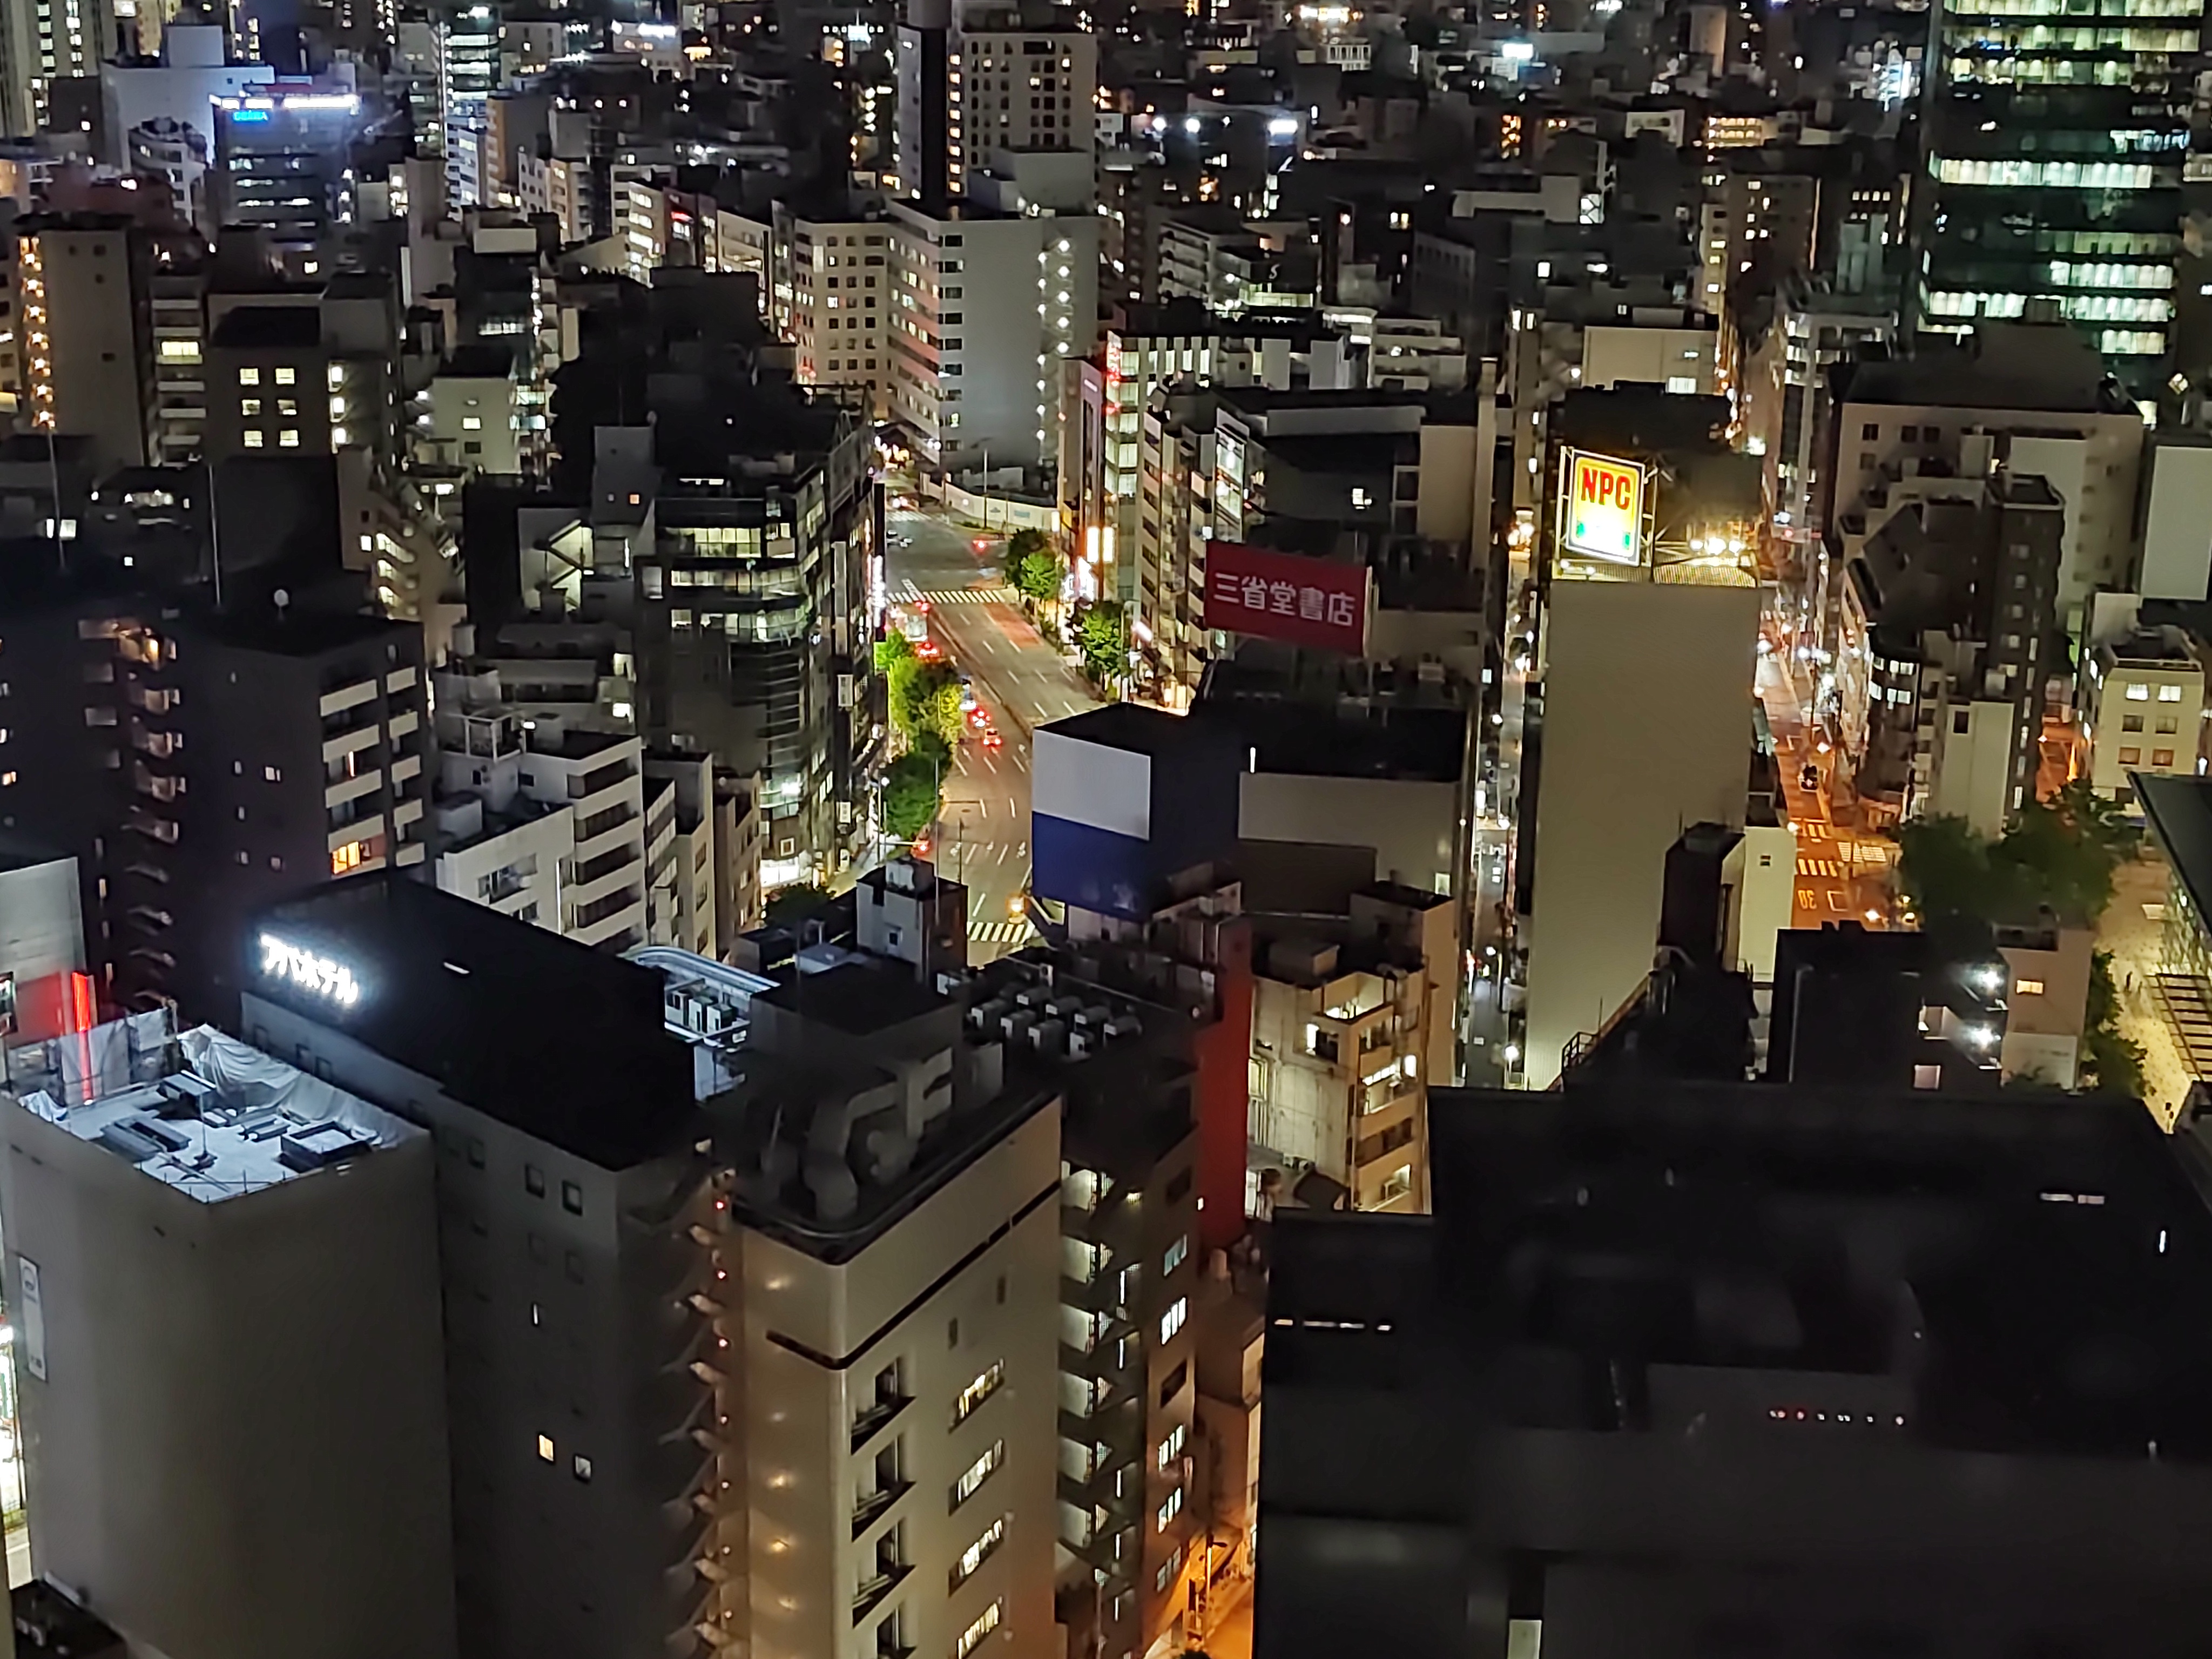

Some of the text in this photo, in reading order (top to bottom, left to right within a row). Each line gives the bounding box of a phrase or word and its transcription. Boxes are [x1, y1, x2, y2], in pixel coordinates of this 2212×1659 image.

[1581, 467, 1630, 510] NPC
[1214, 572, 1355, 626] 三省堂書店
